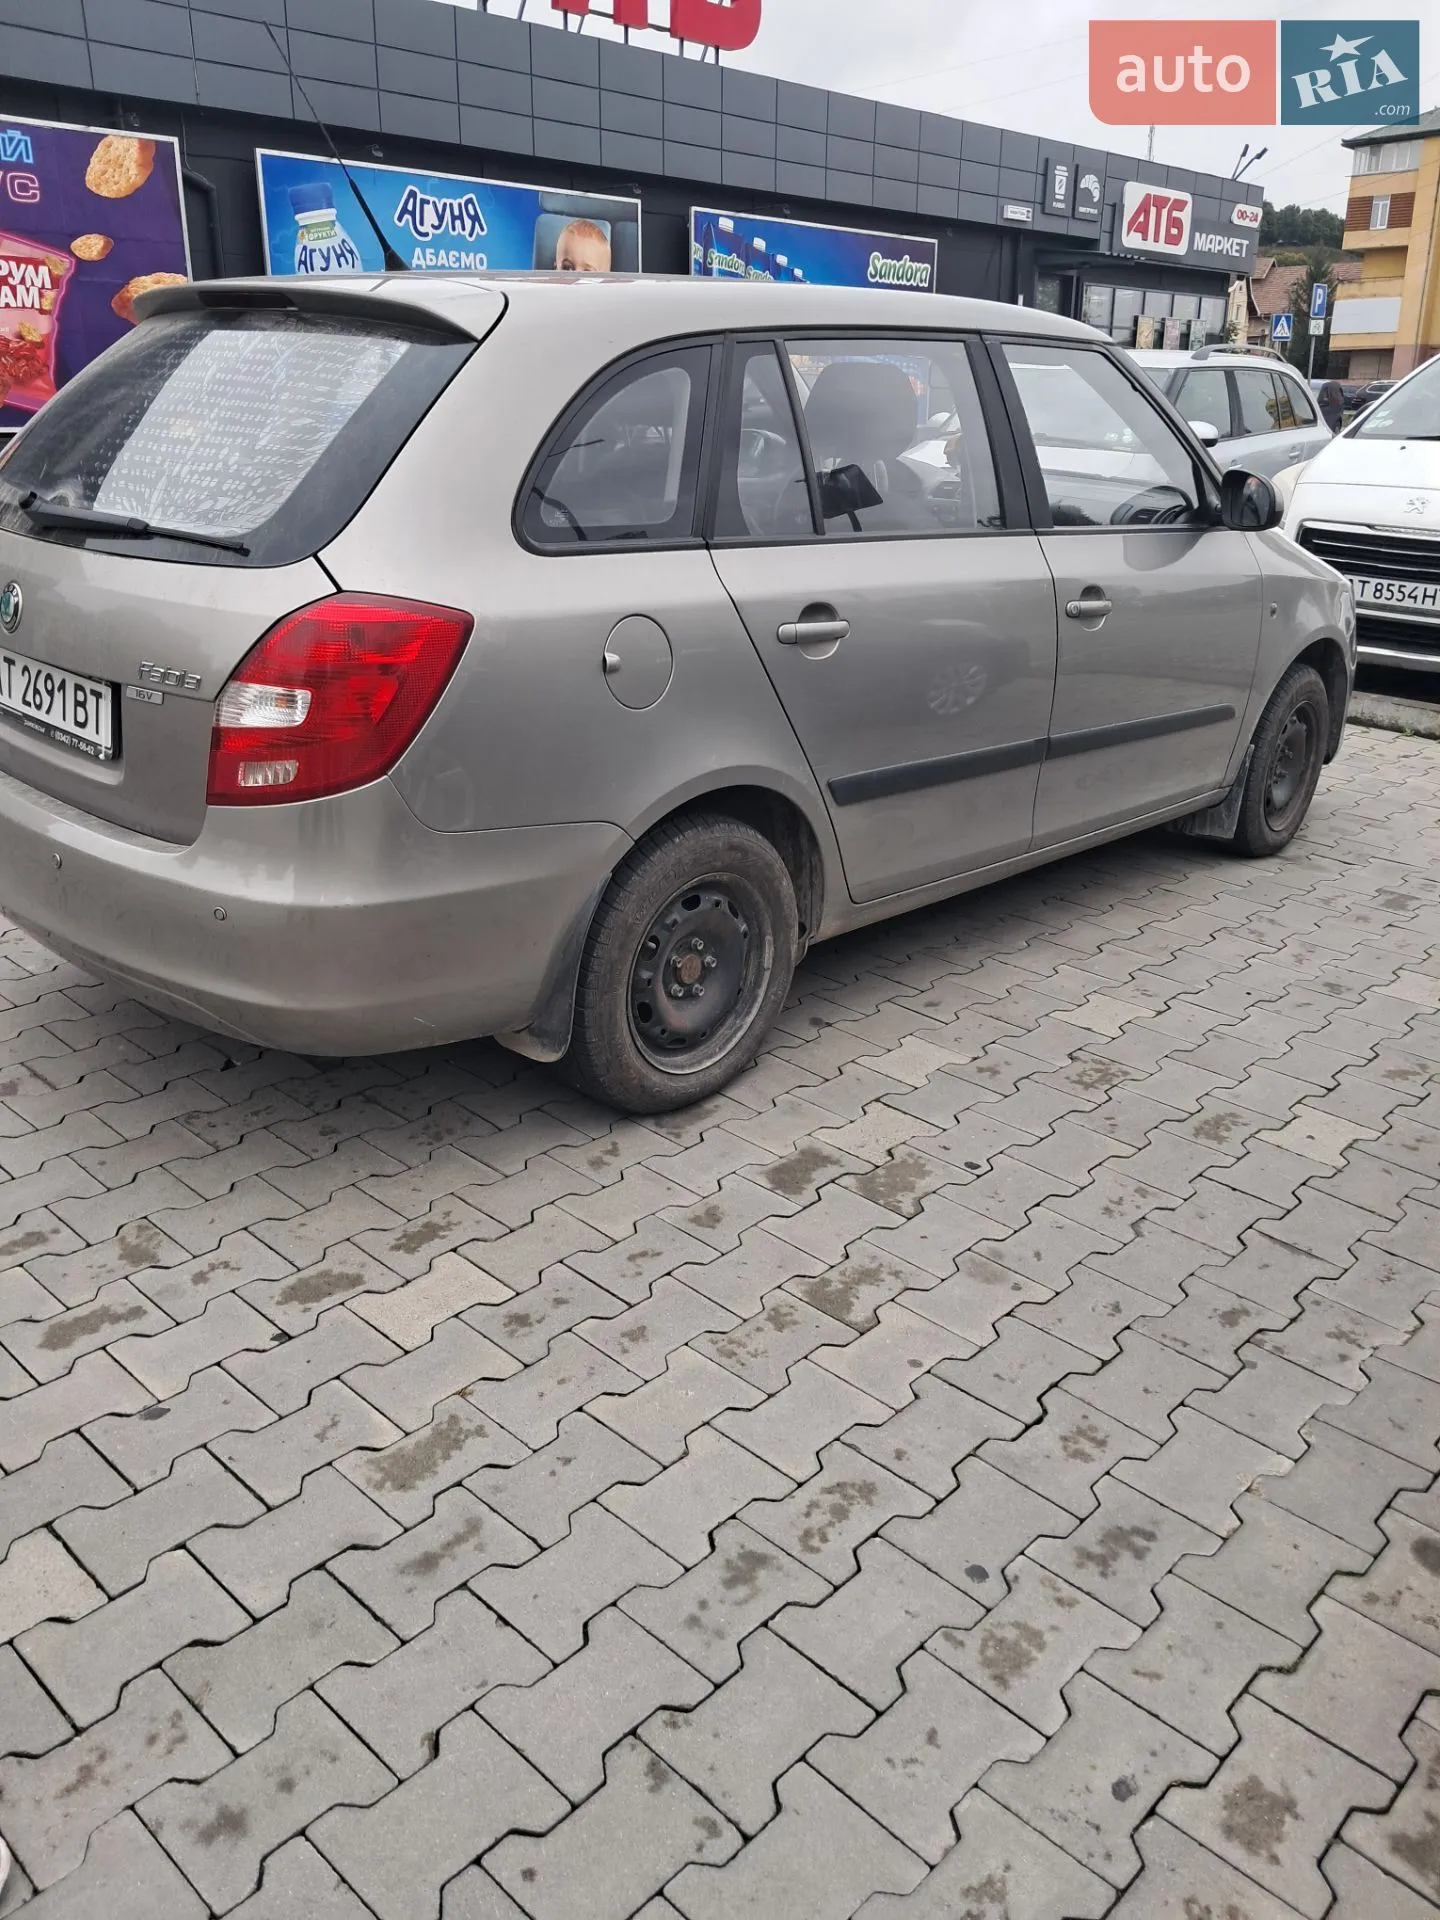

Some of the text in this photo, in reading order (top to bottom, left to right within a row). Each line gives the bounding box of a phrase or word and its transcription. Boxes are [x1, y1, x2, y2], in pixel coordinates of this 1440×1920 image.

[395, 186, 486, 240] АГУНЯ
[1126, 192, 1189, 247] АТБ
[1236, 208, 1259, 223] 00-24
[297, 238, 360, 274] АГУНЯ
[411, 247, 488, 271] ДБАЄМО
[1193, 231, 1250, 258] МАРКЕТ
[868, 252, 931, 287] Sandora
[1314, 288, 1324, 313] P
[1373, 582, 1419, 604] 8554
[1421, 586, 1440, 606] H
[138, 660, 202, 691] Fabia
[0, 656, 103, 735] T 2691 BT
[135, 689, 153, 701] 16V
